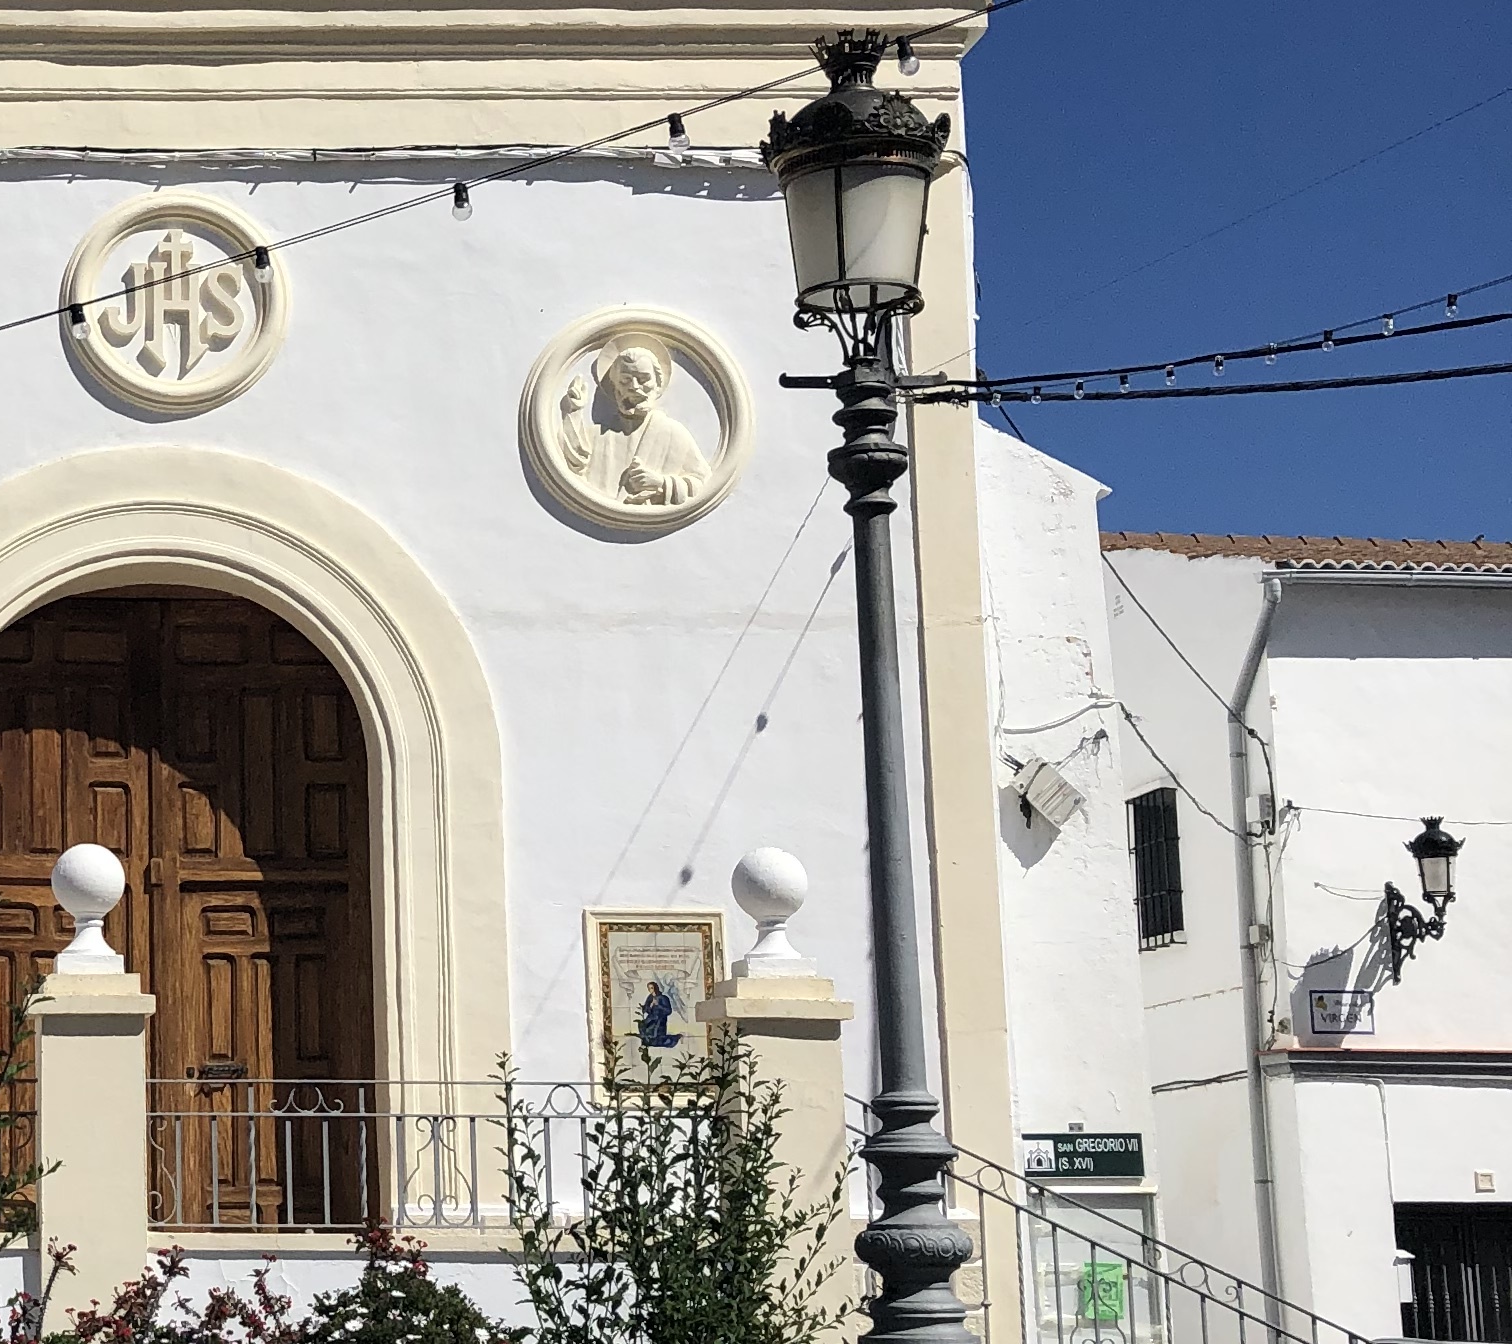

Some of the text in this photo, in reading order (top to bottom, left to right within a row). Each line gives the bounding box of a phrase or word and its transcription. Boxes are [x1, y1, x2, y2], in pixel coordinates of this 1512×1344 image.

[1057, 1143, 1074, 1152] SAN
[1075, 1138, 1125, 1152] GREGORIO
[1058, 1157, 1094, 1172] (S. XVI)
